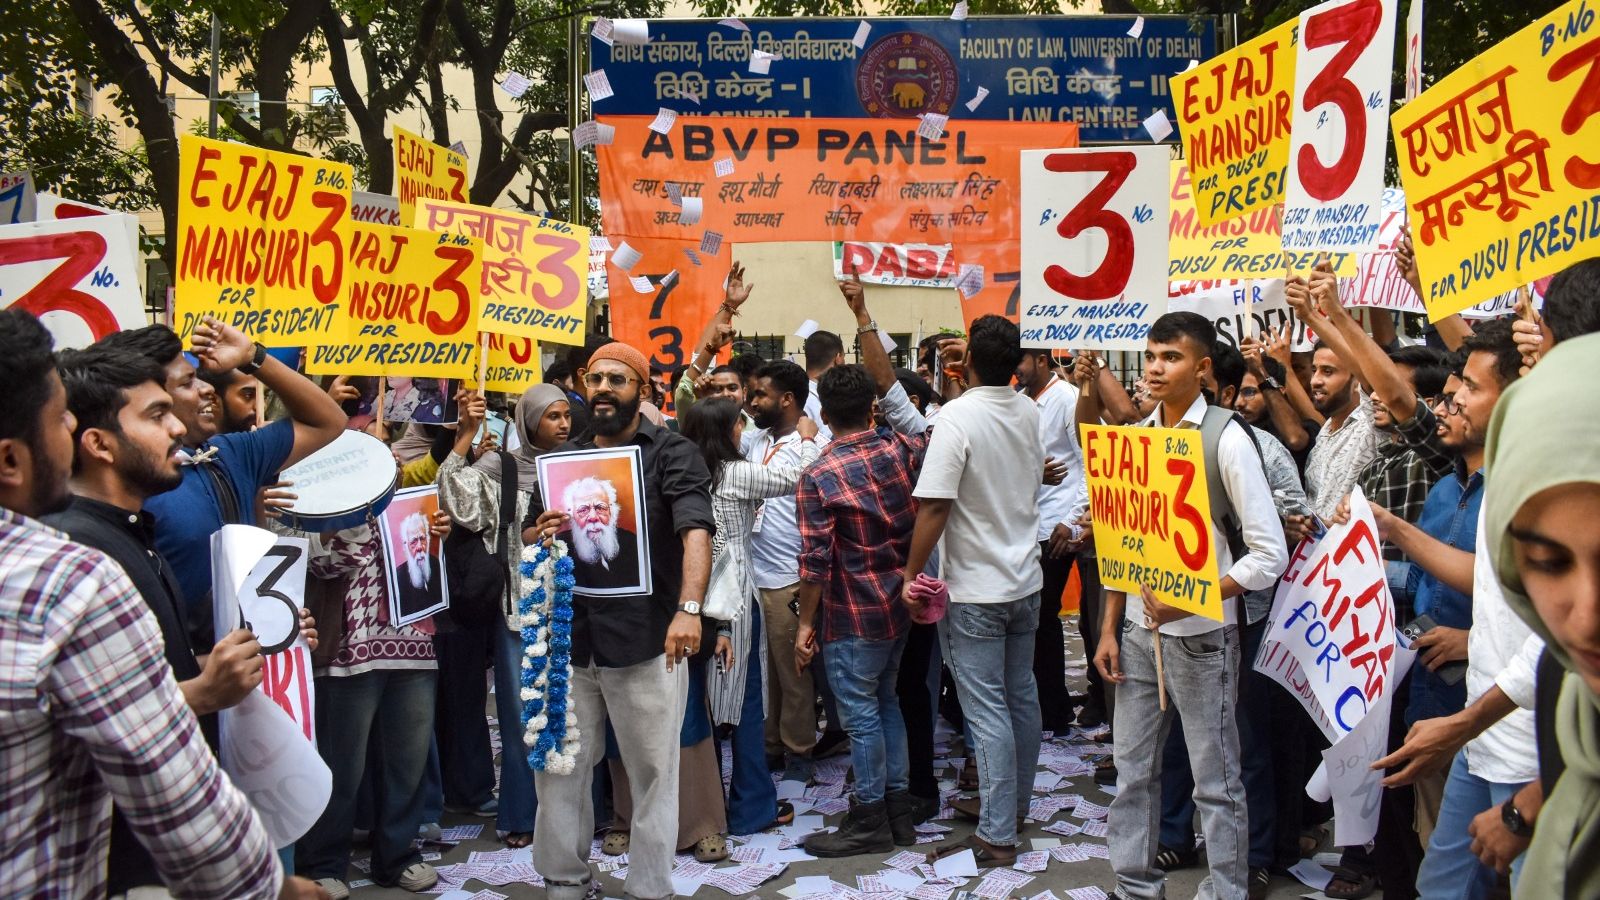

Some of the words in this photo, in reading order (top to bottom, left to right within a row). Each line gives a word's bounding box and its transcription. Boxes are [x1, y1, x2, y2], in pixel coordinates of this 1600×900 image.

[707, 31, 753, 62] दिल्ली
[959, 38, 1014, 59] FACULTY
[1017, 38, 1034, 58] OF
[1037, 38, 1067, 61] LAW,
[1070, 37, 1144, 58] UNIVERSITY
[1147, 37, 1163, 58] OF
[1166, 37, 1202, 58] DELHI
[654, 71, 710, 100] विधि
[714, 70, 774, 103] केन्द्र
[1005, 67, 1060, 95] विधि
[1183, 41, 1279, 124] EJAJ
[1058, 106, 1138, 128] CENTRE
[1297, 0, 1382, 201] 3
[398, 134, 435, 178] EJAJ
[641, 125, 800, 162] ABVP
[817, 128, 986, 165] PANEL
[190, 146, 304, 221] EJAJ
[447, 167, 467, 204] 3
[1197, 173, 1218, 193] FOR
[1226, 149, 1268, 180] DUSU
[1210, 165, 1288, 219] PRESI
[1043, 151, 1137, 301] 3
[1284, 207, 1311, 225] EJAJ
[1312, 203, 1370, 226] MANSURI
[310, 191, 347, 304] 3
[1210, 237, 1249, 251] FOR
[1316, 223, 1379, 246] PRESIDENT
[180, 224, 310, 290] MANSURI
[532, 233, 581, 311] 3
[1168, 256, 1218, 276] DUSU
[1431, 273, 1457, 303] FOR
[1459, 237, 1509, 291] DUSU
[217, 287, 255, 308] FOR
[426, 246, 475, 336] 3
[232, 303, 340, 337] PRESIDENT
[482, 303, 583, 335] PRESIDENT
[1026, 304, 1069, 318] EJAJ
[1072, 302, 1149, 319] MANSURI
[359, 324, 399, 338] FOR
[648, 326, 683, 372] 3
[1020, 328, 1043, 341] FOR
[1044, 322, 1083, 341] DUSU
[313, 344, 364, 365] DUSU
[364, 341, 475, 366] PRESIDENT
[473, 364, 534, 383] SIDENT
[1087, 430, 1152, 488] EJAJ
[1091, 485, 1170, 542] MANSURI
[1166, 457, 1209, 572] 3
[1122, 535, 1144, 557] FOR
[1101, 557, 1125, 581] DUSU
[1128, 562, 1212, 606] PRESIDENT
